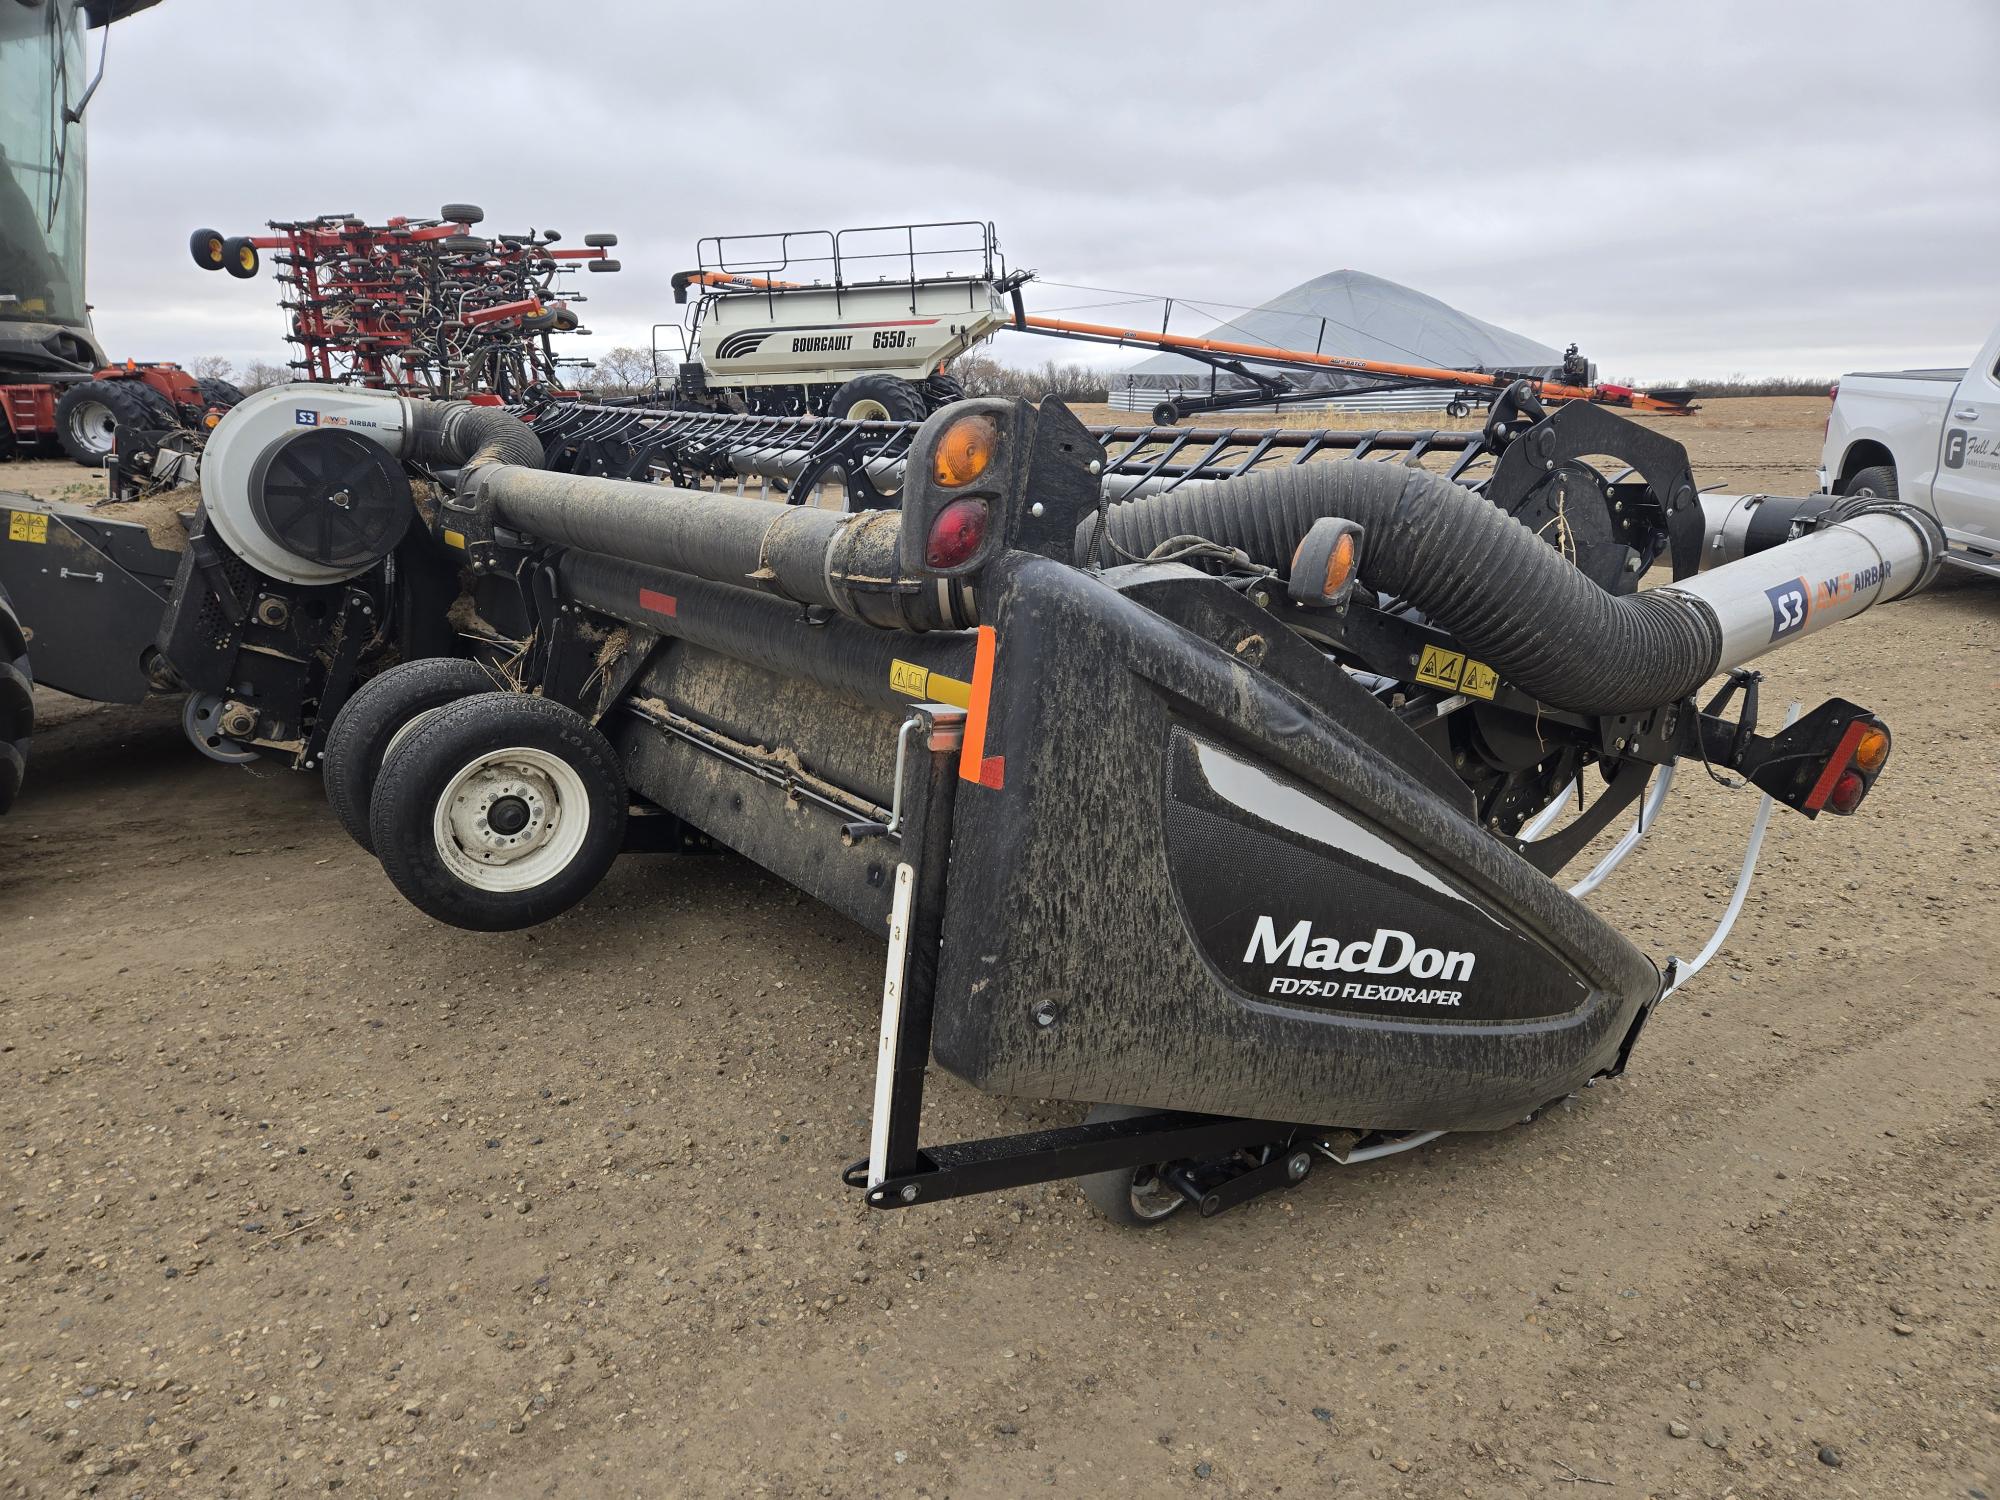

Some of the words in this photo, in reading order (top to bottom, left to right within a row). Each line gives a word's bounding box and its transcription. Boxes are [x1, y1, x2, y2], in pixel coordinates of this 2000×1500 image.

[792, 336, 853, 352] BOURGAULT
[873, 331, 905, 348] 6550
[907, 337, 916, 347] ST
[299, 412, 315, 424] S3
[322, 416, 348, 426] AWS
[349, 420, 377, 428] AIRBAR
[1966, 436, 1990, 456] Full
[1778, 590, 1803, 632] S3
[1816, 572, 1854, 609] AWS
[1853, 560, 1892, 593] AIRBAR
[901, 871, 907, 884] 4
[895, 926, 901, 940] 3
[1243, 915, 1476, 982] MacDon
[889, 981, 895, 996] 2
[1268, 977, 1339, 997] FD75-D
[1341, 983, 1463, 1007] FLEXDRAPER
[884, 1037, 889, 1050] 1
